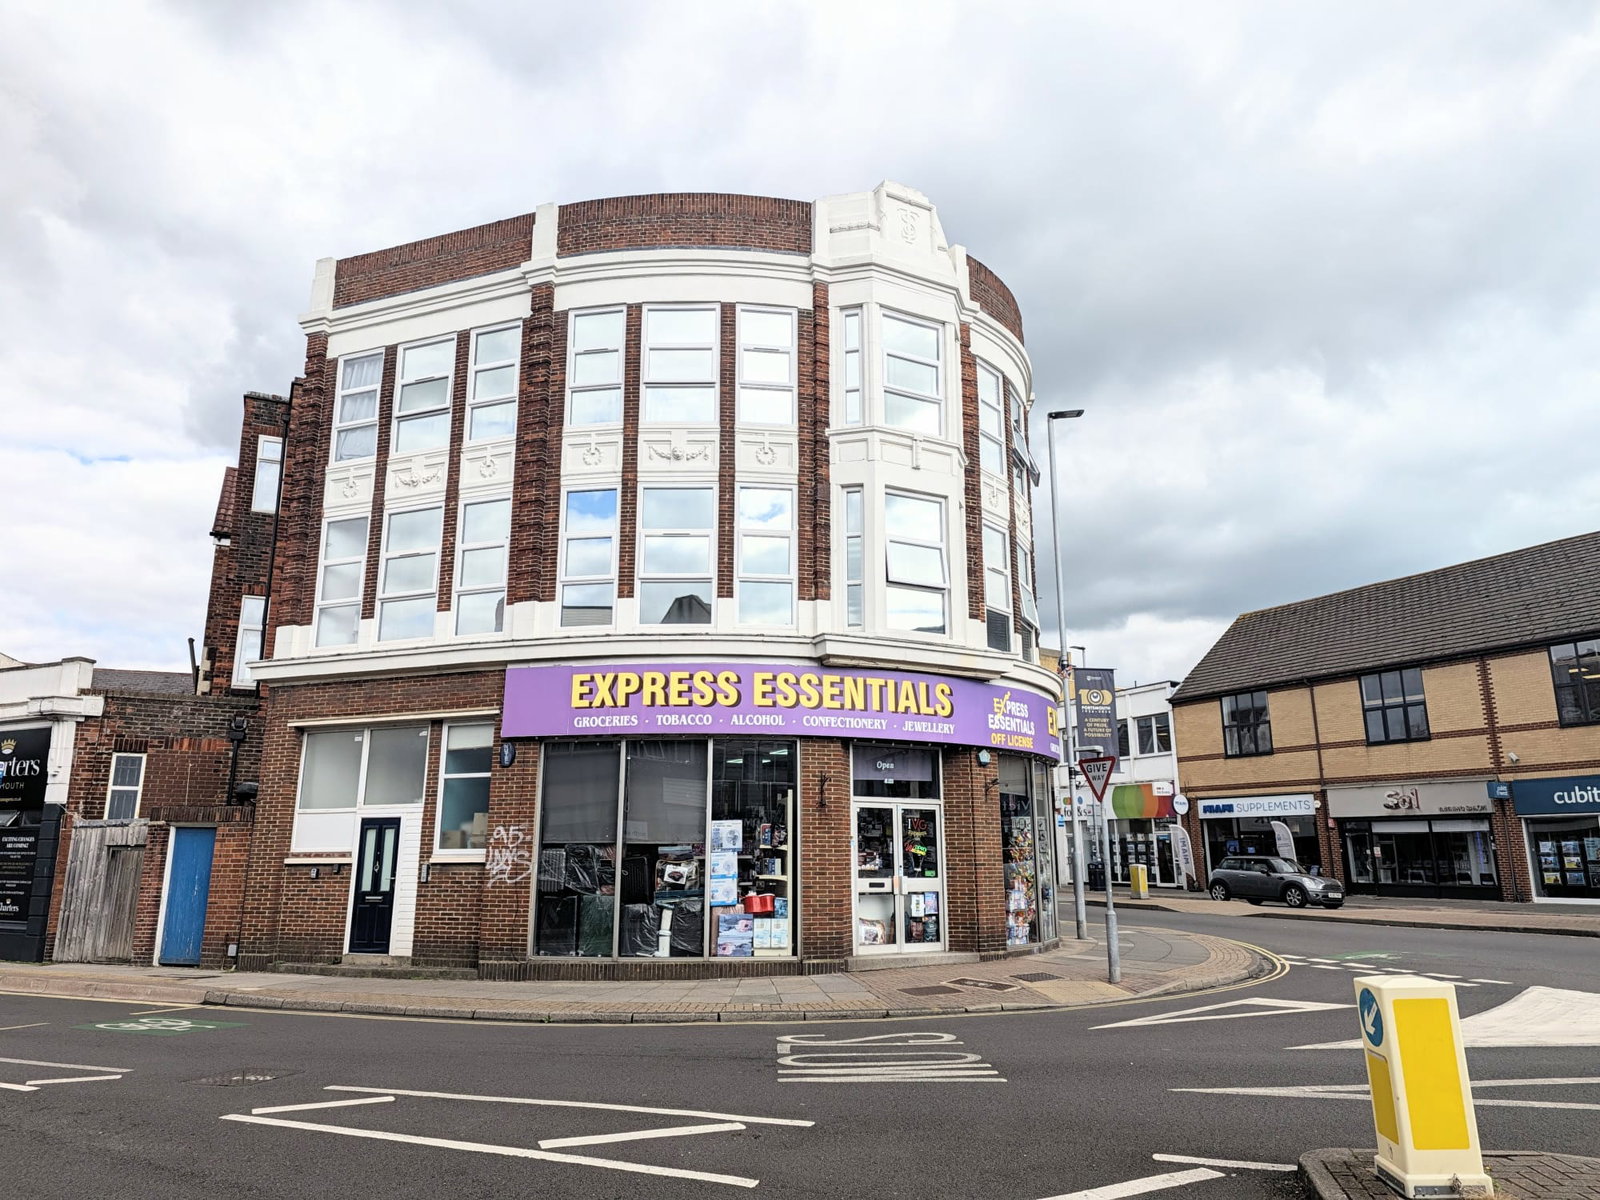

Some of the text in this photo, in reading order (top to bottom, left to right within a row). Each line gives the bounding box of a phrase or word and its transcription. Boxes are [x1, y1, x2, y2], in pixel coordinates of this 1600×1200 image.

[570, 670, 954, 718] EXPRESS ESSENTIALS
[993, 691, 1029, 718] EXPRESS
[573, 713, 955, 735] GROCERIES TOBACCO ALCOHOL CONFECTIONERY JEWELLERY
[988, 713, 1035, 736] ESSENTIALS
[991, 732, 1006, 746] OFF
[1007, 734, 1034, 749] LICENSE
[3, 756, 41, 777] rters
[876, 760, 895, 771] Open
[1086, 763, 1107, 773] GIVE
[1236, 799, 1311, 813] SUPPLEMENTS
